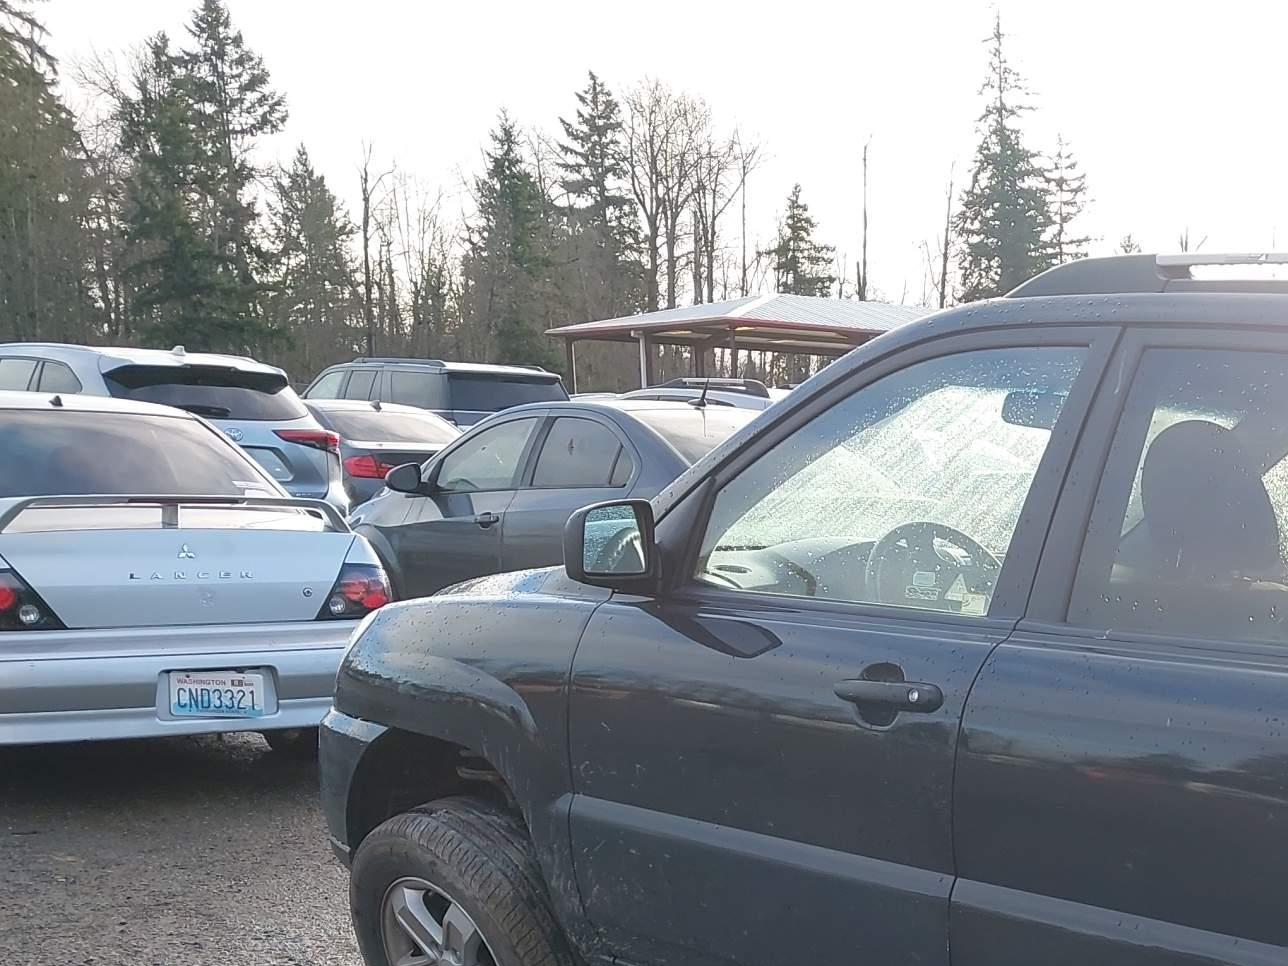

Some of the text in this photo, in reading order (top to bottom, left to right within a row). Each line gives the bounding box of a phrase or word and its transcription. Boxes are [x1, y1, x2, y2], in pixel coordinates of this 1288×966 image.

[128, 570, 255, 580] LANCER
[177, 678, 226, 687] WASHINGTON
[177, 687, 256, 711] CND3321
